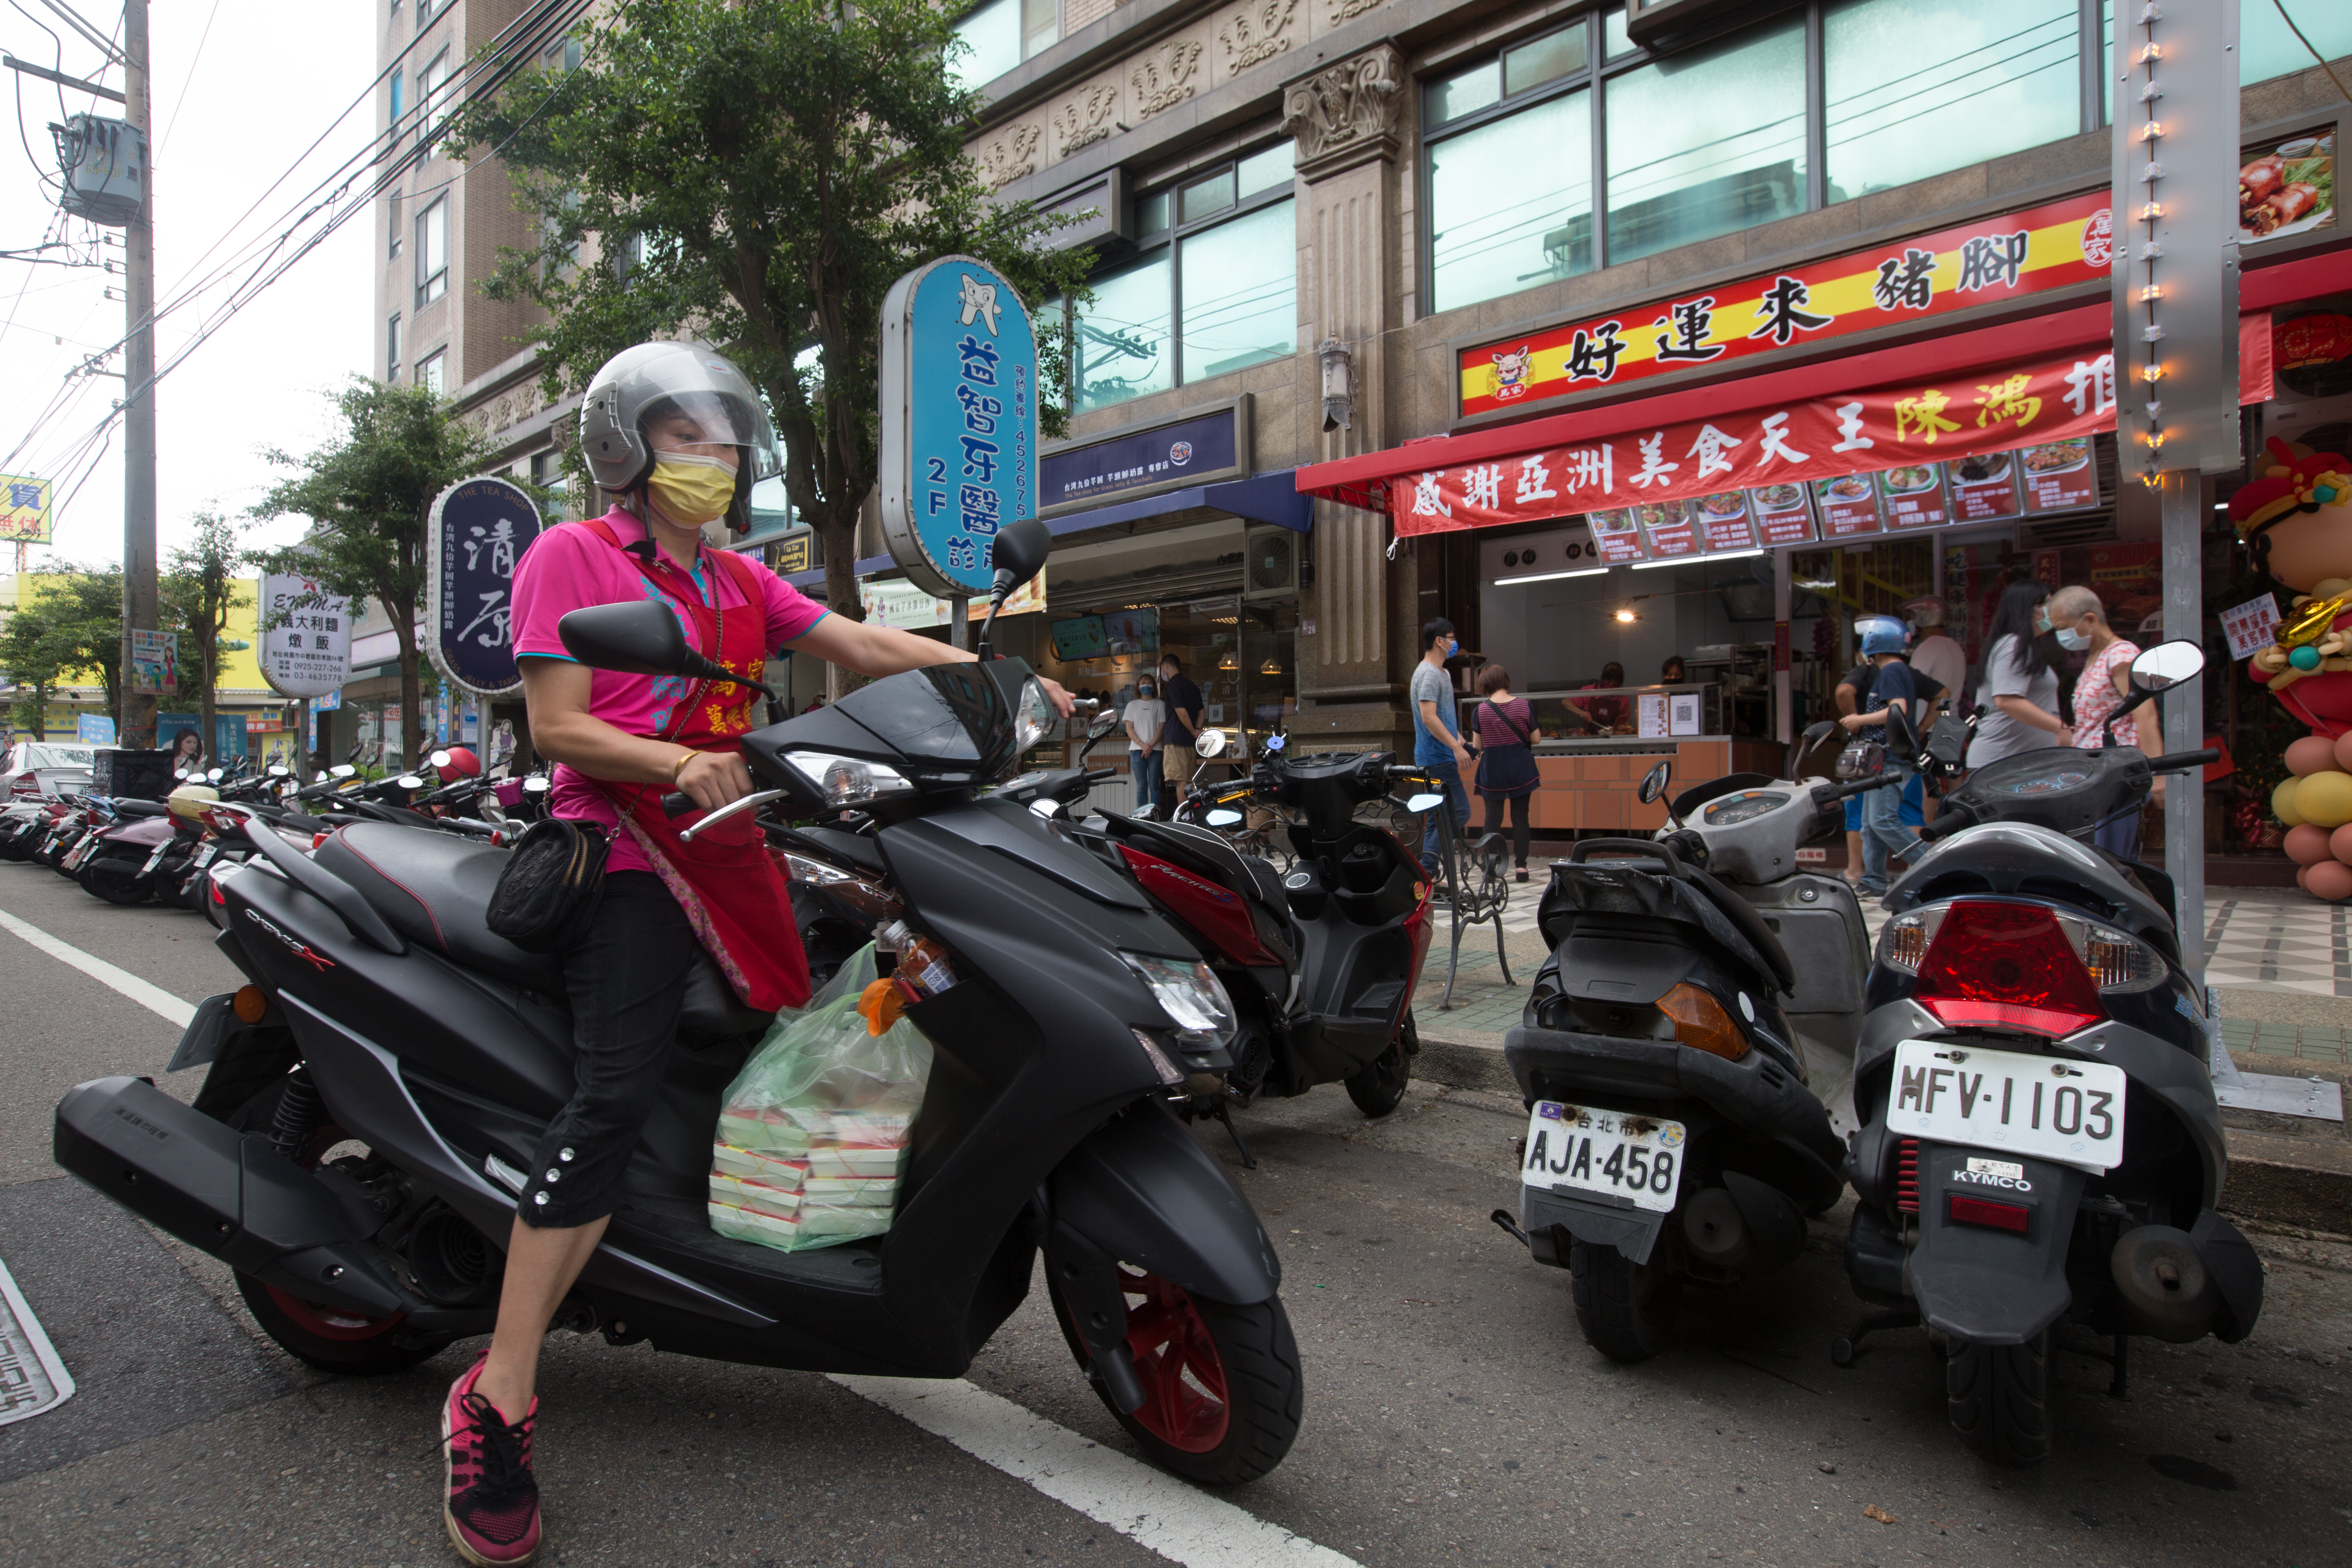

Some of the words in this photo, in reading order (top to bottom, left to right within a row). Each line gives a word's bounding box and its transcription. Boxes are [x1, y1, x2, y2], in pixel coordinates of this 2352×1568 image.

[1564, 231, 2029, 383] 好運來豬腳
[957, 335, 1002, 537] 益智牙醫
[1015, 364, 1027, 522] 預約專線:452675
[457, 486, 477, 500] THE
[481, 486, 499, 496] TEA
[503, 491, 529, 512] SHOP
[927, 457, 947, 515] 2F
[294, 662, 342, 673] 0925-227-266
[294, 672, 342, 682] 03-4635778
[444, 648, 461, 673] GRASS
[463, 675, 486, 687] JELLY
[498, 675, 518, 687] TARO
[1577, 1113, 1635, 1136] 台北市
[1953, 1170, 2032, 1192] KYMCO
